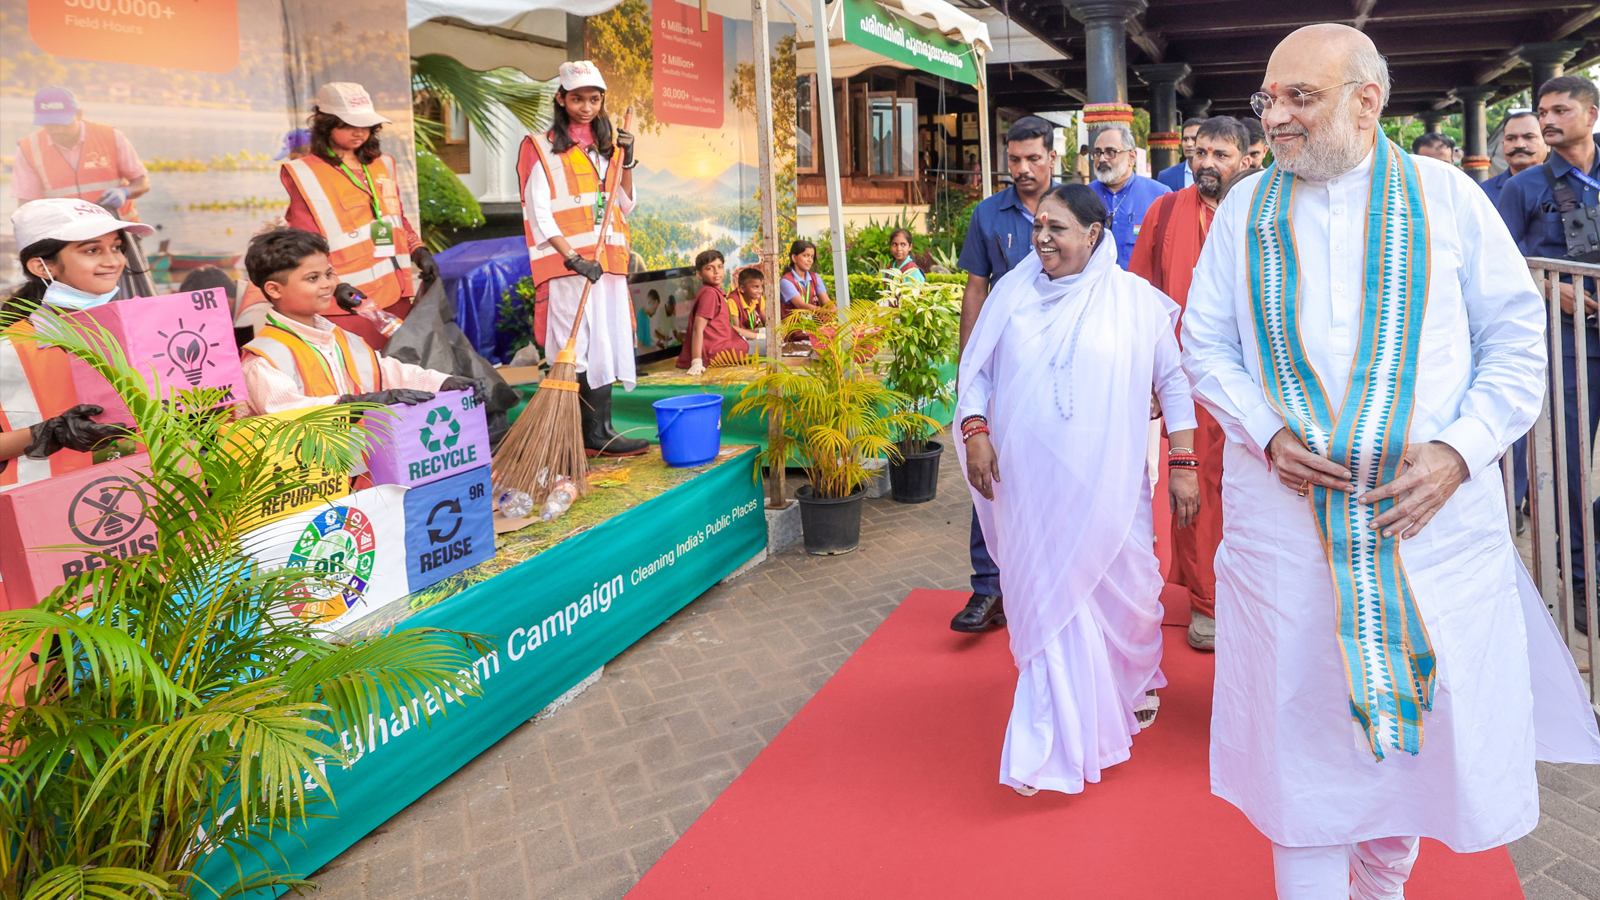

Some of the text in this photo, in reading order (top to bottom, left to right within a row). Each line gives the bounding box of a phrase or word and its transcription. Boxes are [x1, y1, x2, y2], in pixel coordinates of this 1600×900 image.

[65, 14, 144, 35] Field Hours
[661, 19, 694, 36] 6 Million+
[661, 53, 695, 69] 2 Million+
[662, 87, 690, 100] 30,000+
[191, 290, 218, 311] 9R
[408, 444, 477, 481] RECYCLE
[469, 482, 485, 501] 9R
[420, 536, 473, 574] REUSE
[507, 573, 624, 662] Campaign
[630, 550, 675, 586] Cleaning
[676, 530, 704, 558] India's
[705, 516, 731, 540] Public
[732, 498, 758, 522] Places
